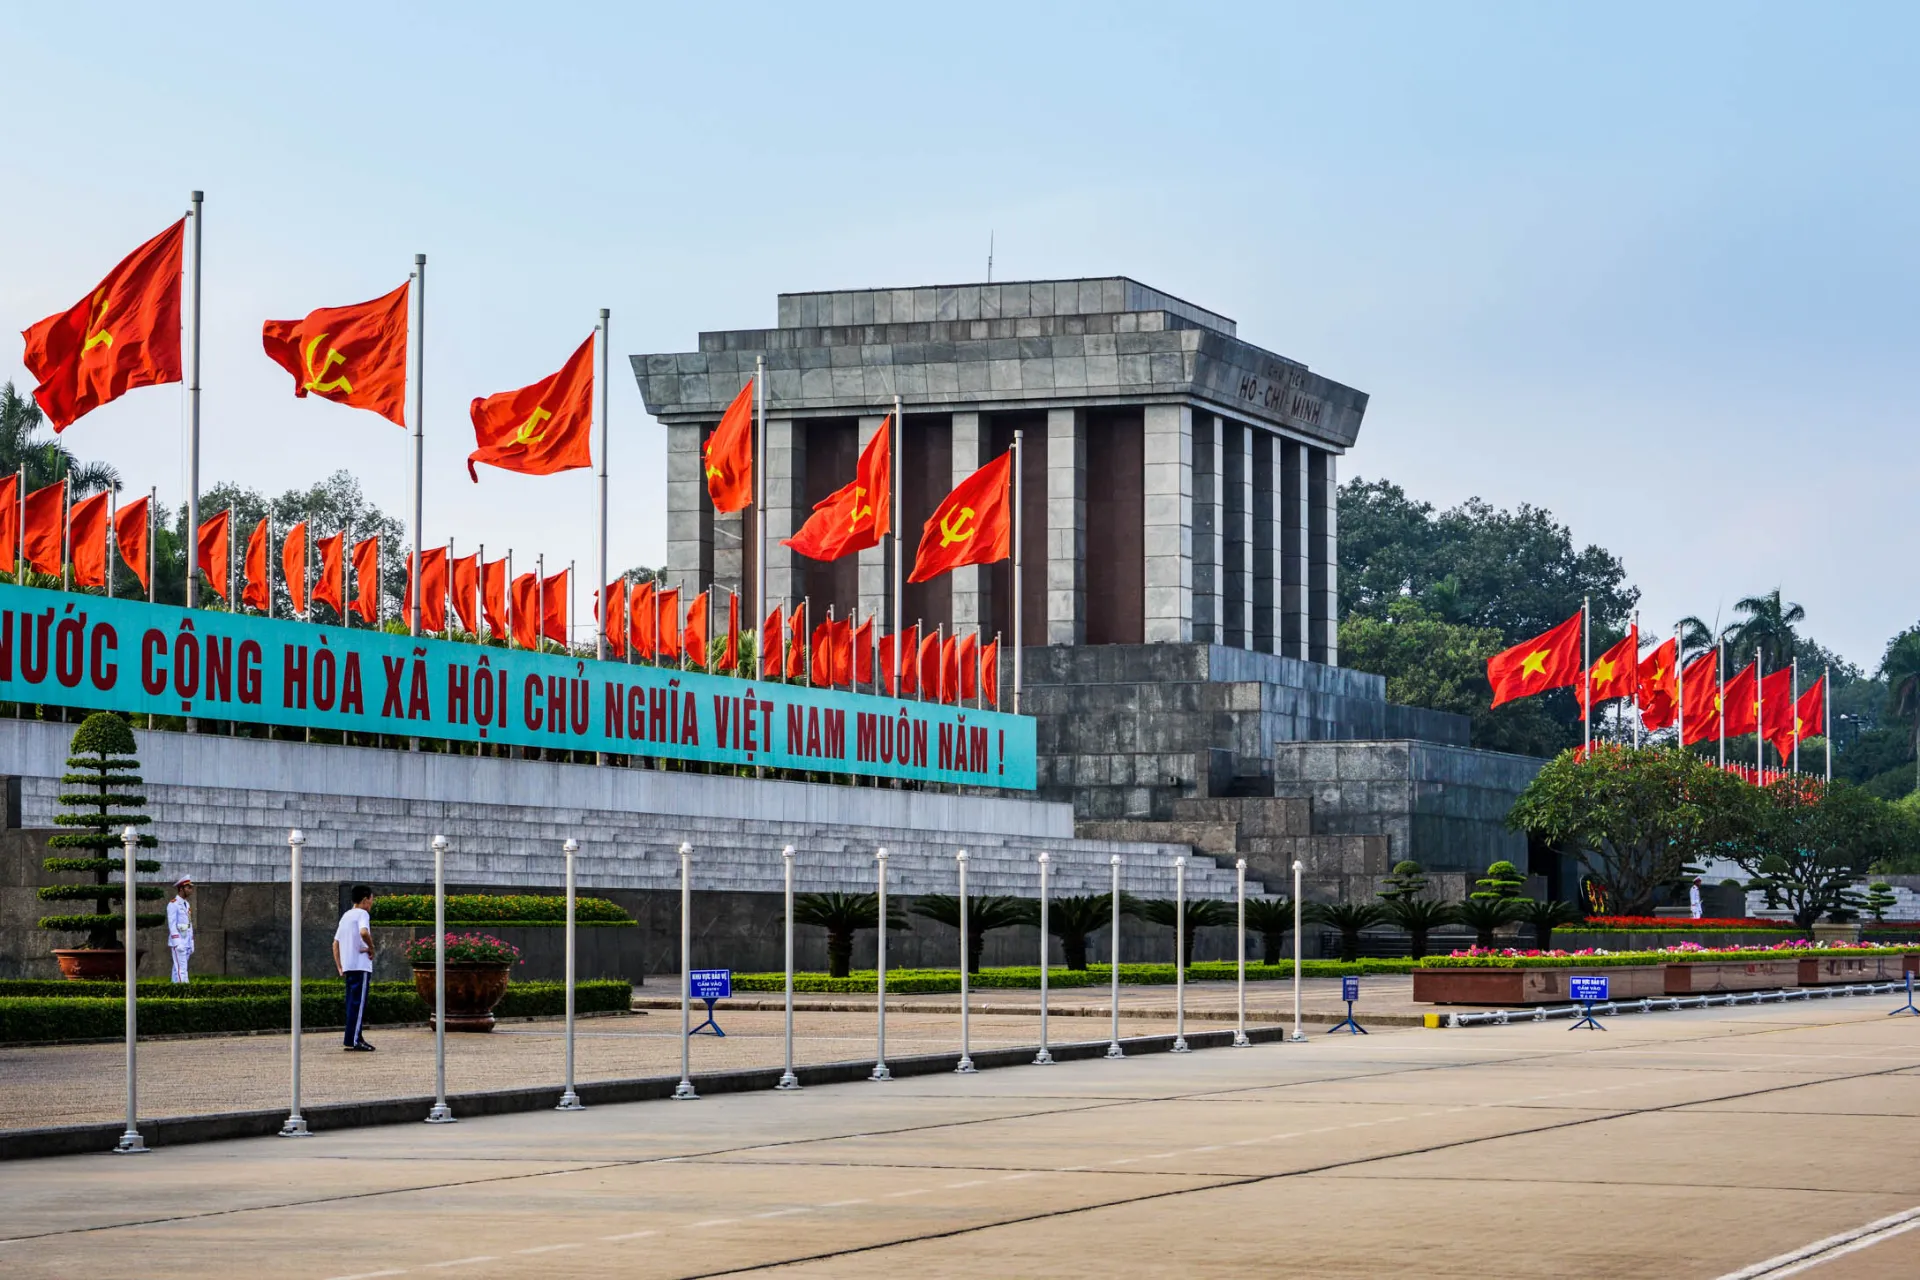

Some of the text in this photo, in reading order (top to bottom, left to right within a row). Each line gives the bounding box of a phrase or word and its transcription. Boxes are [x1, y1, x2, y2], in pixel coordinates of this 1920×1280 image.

[142, 617, 262, 713] CỘNG
[284, 635, 364, 717] HÒA
[382, 648, 430, 721] XÃ
[448, 655, 508, 738] HỘI
[524, 662, 589, 735] CHỦ
[606, 680, 699, 747] NGHĨA
[714, 688, 774, 761] VIỆT
[787, 703, 845, 759] NAM
[857, 707, 928, 767] MUÔN
[939, 715, 988, 773] NĂM
